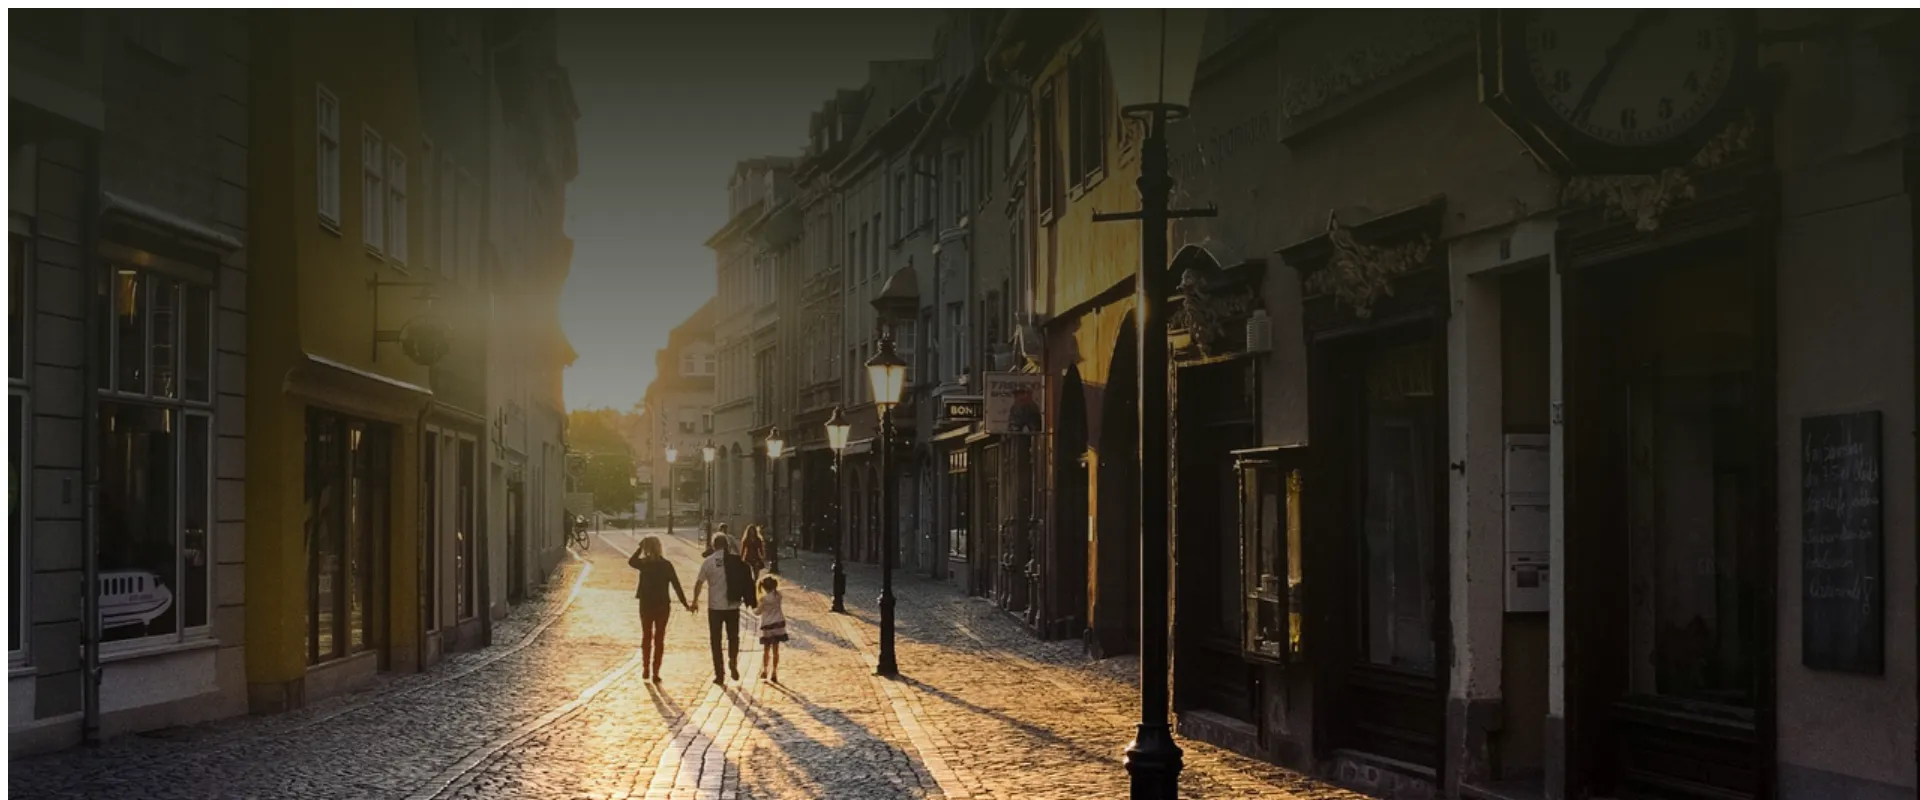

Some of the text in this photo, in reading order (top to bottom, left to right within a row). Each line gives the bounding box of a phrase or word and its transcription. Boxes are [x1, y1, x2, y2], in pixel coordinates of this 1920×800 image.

[1553, 68, 1572, 92] 8
[1683, 70, 1701, 93] 4
[1620, 107, 1637, 130] 6
[1658, 96, 1676, 119] 5
